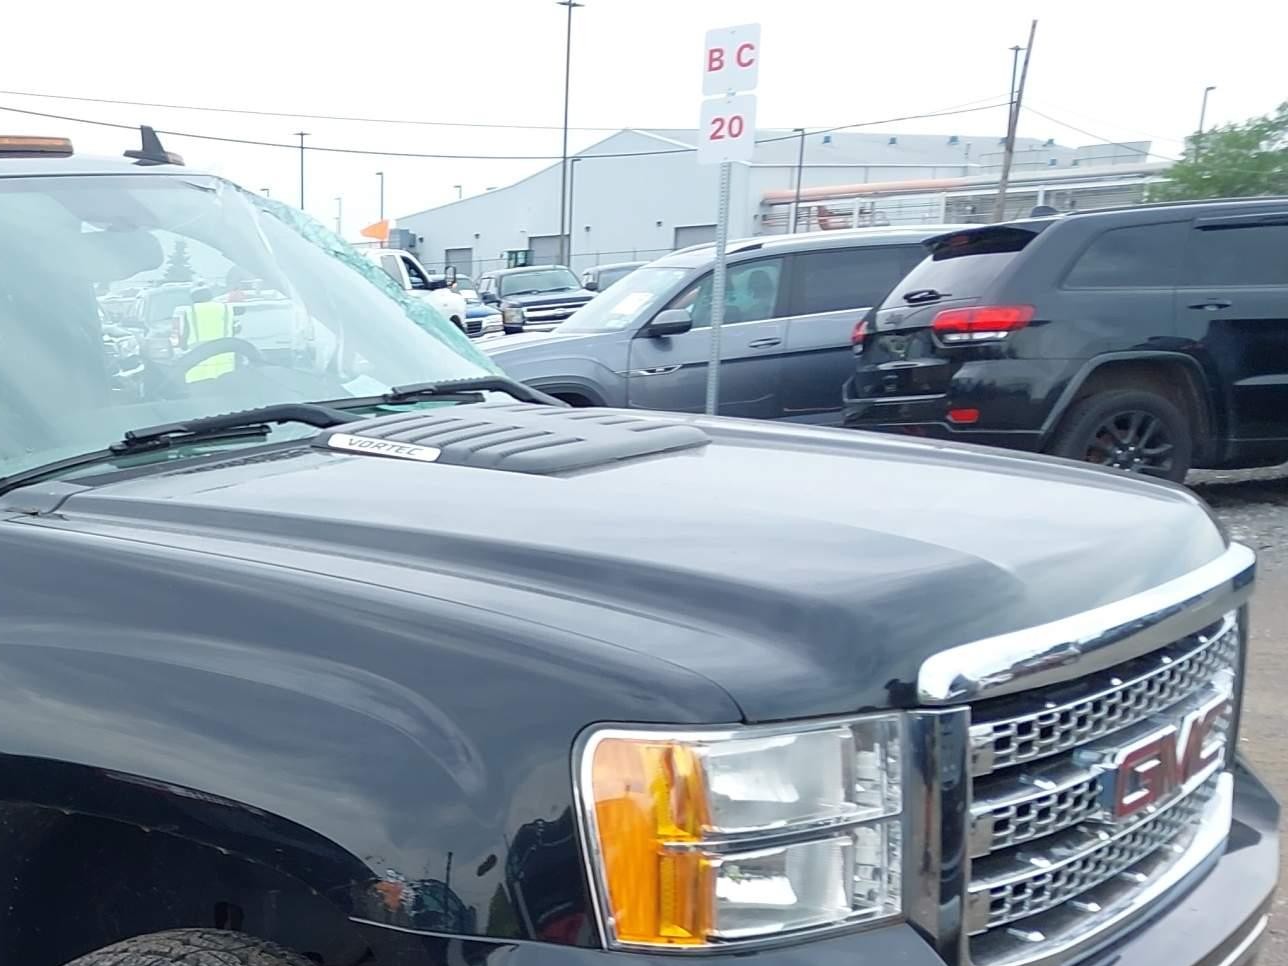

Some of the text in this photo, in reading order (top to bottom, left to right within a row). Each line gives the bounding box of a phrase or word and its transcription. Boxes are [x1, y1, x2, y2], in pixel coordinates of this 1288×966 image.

[707, 43, 755, 72] B C
[709, 115, 744, 140] 20
[348, 438, 425, 456] VORTEC
[1114, 692, 1233, 818] GMC
